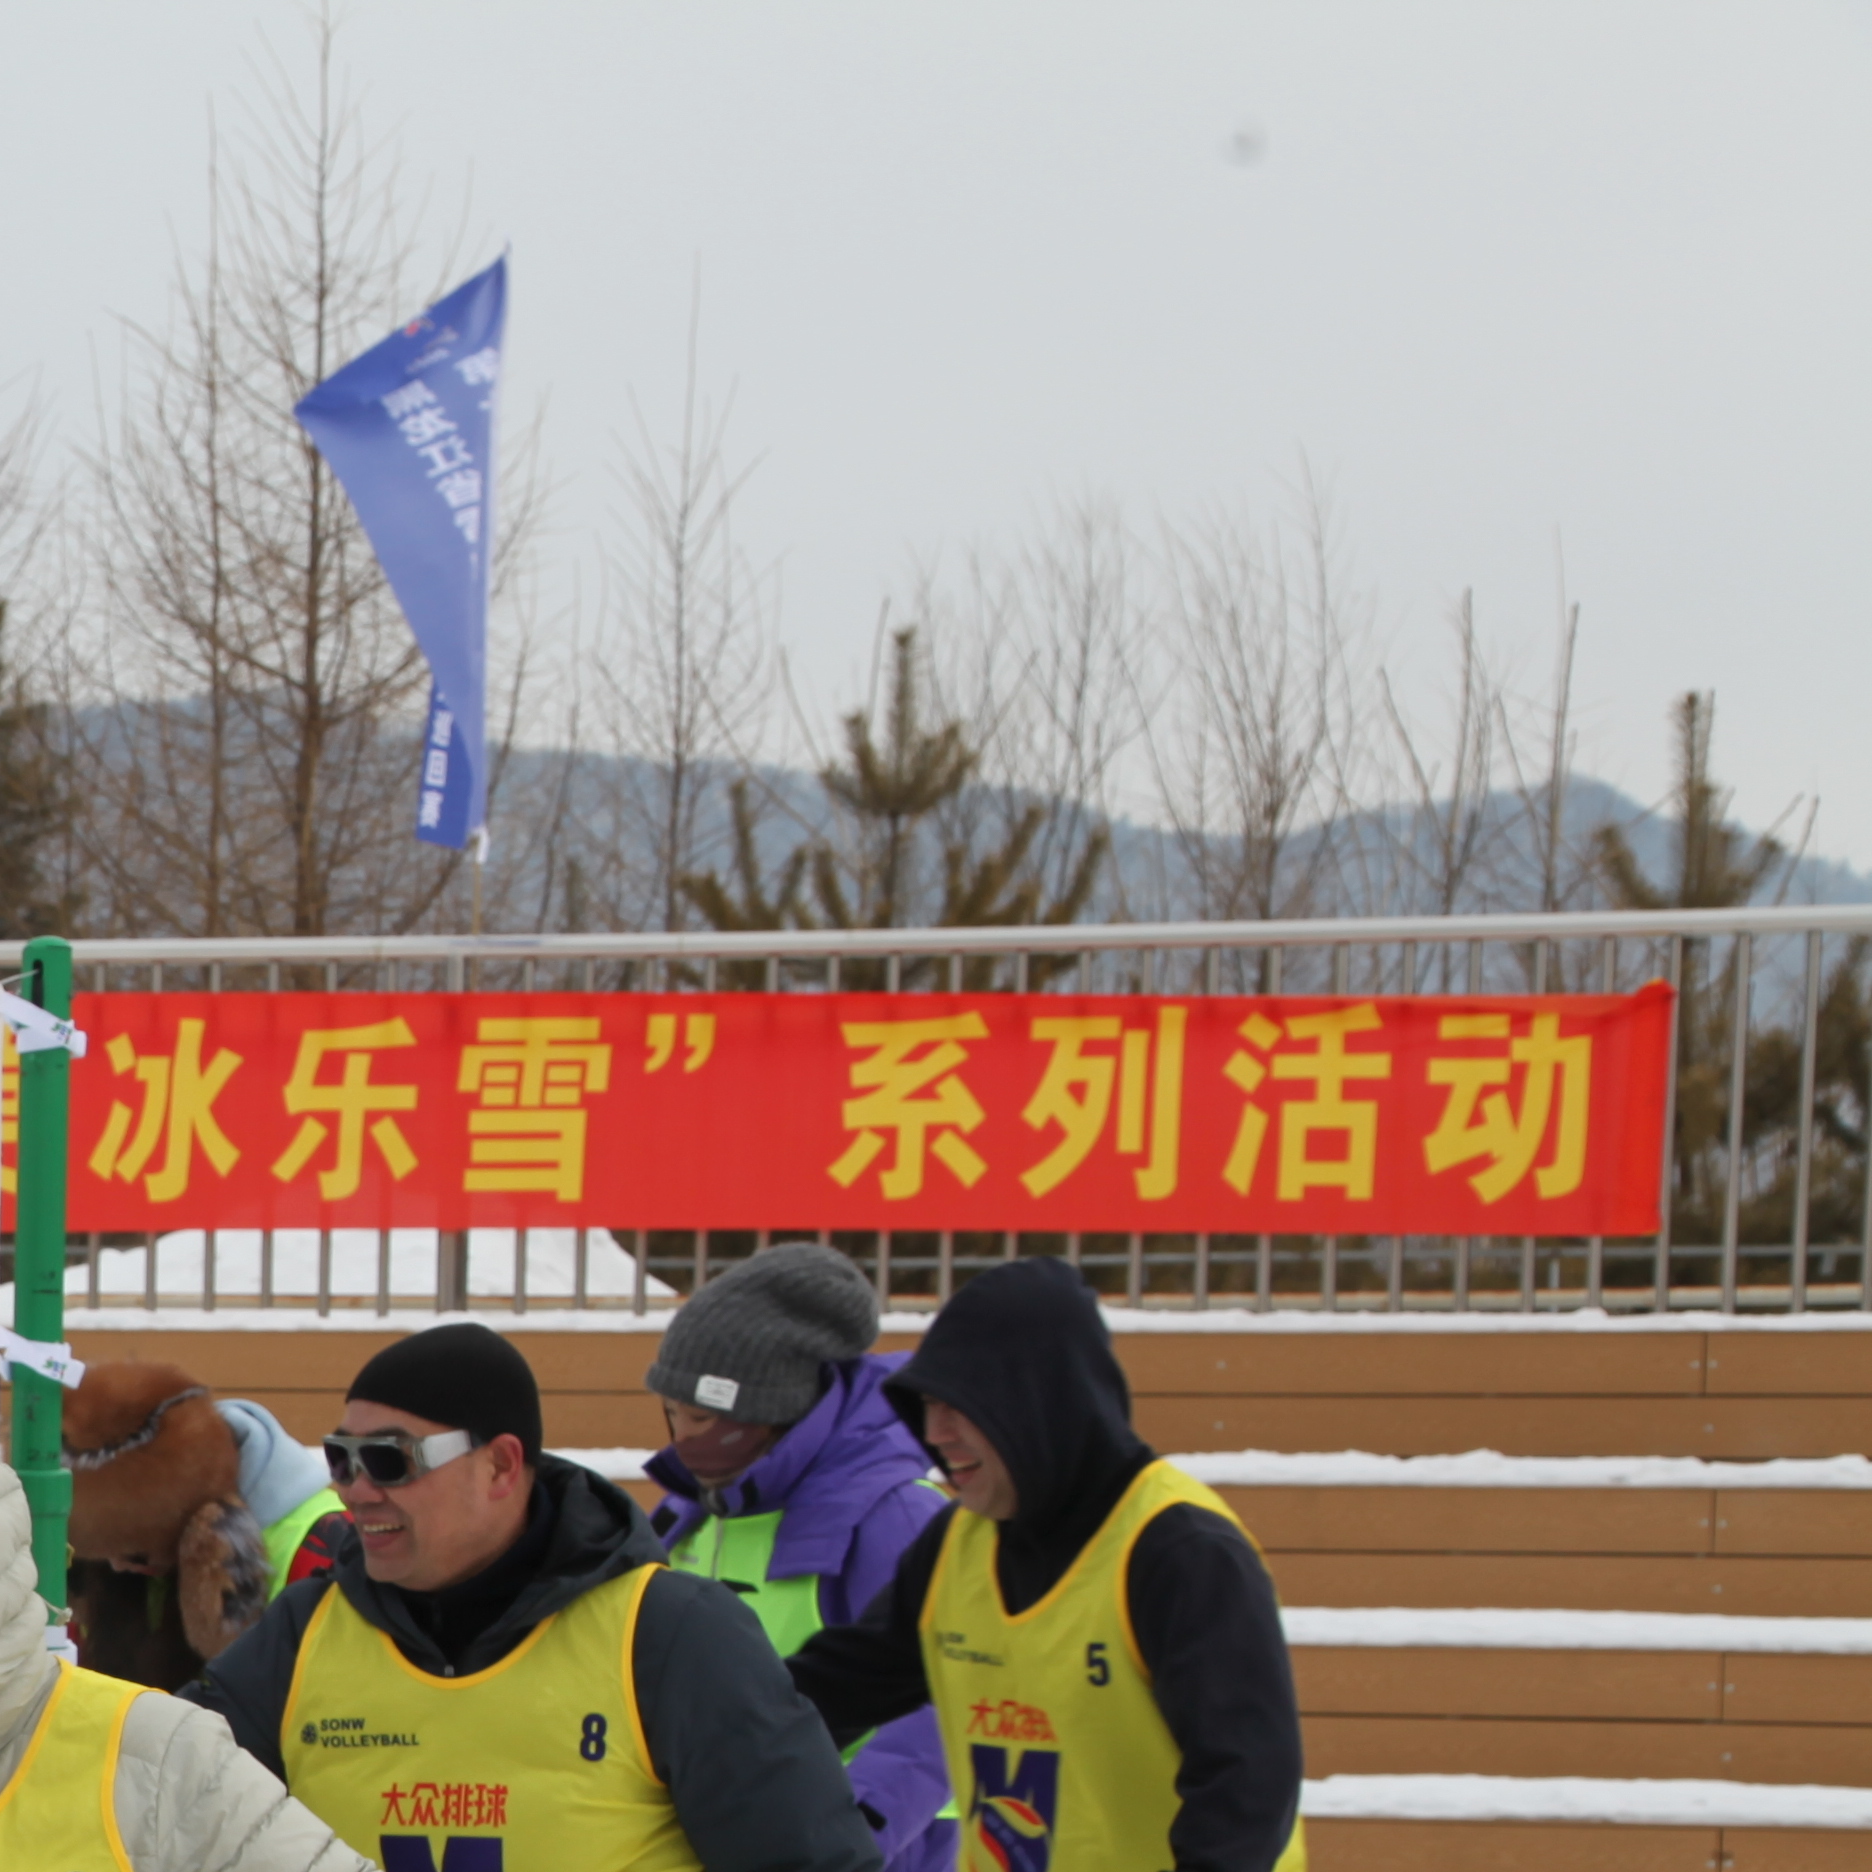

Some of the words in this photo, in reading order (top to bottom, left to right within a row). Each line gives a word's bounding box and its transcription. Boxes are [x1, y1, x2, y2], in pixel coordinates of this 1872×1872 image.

[1086, 1643, 1111, 1686] 5
[321, 1718, 366, 1732] SONW
[321, 1733, 420, 1748] VOLLEYBALL
[579, 1713, 608, 1762] 8
[381, 1782, 509, 1828] 大众排球
